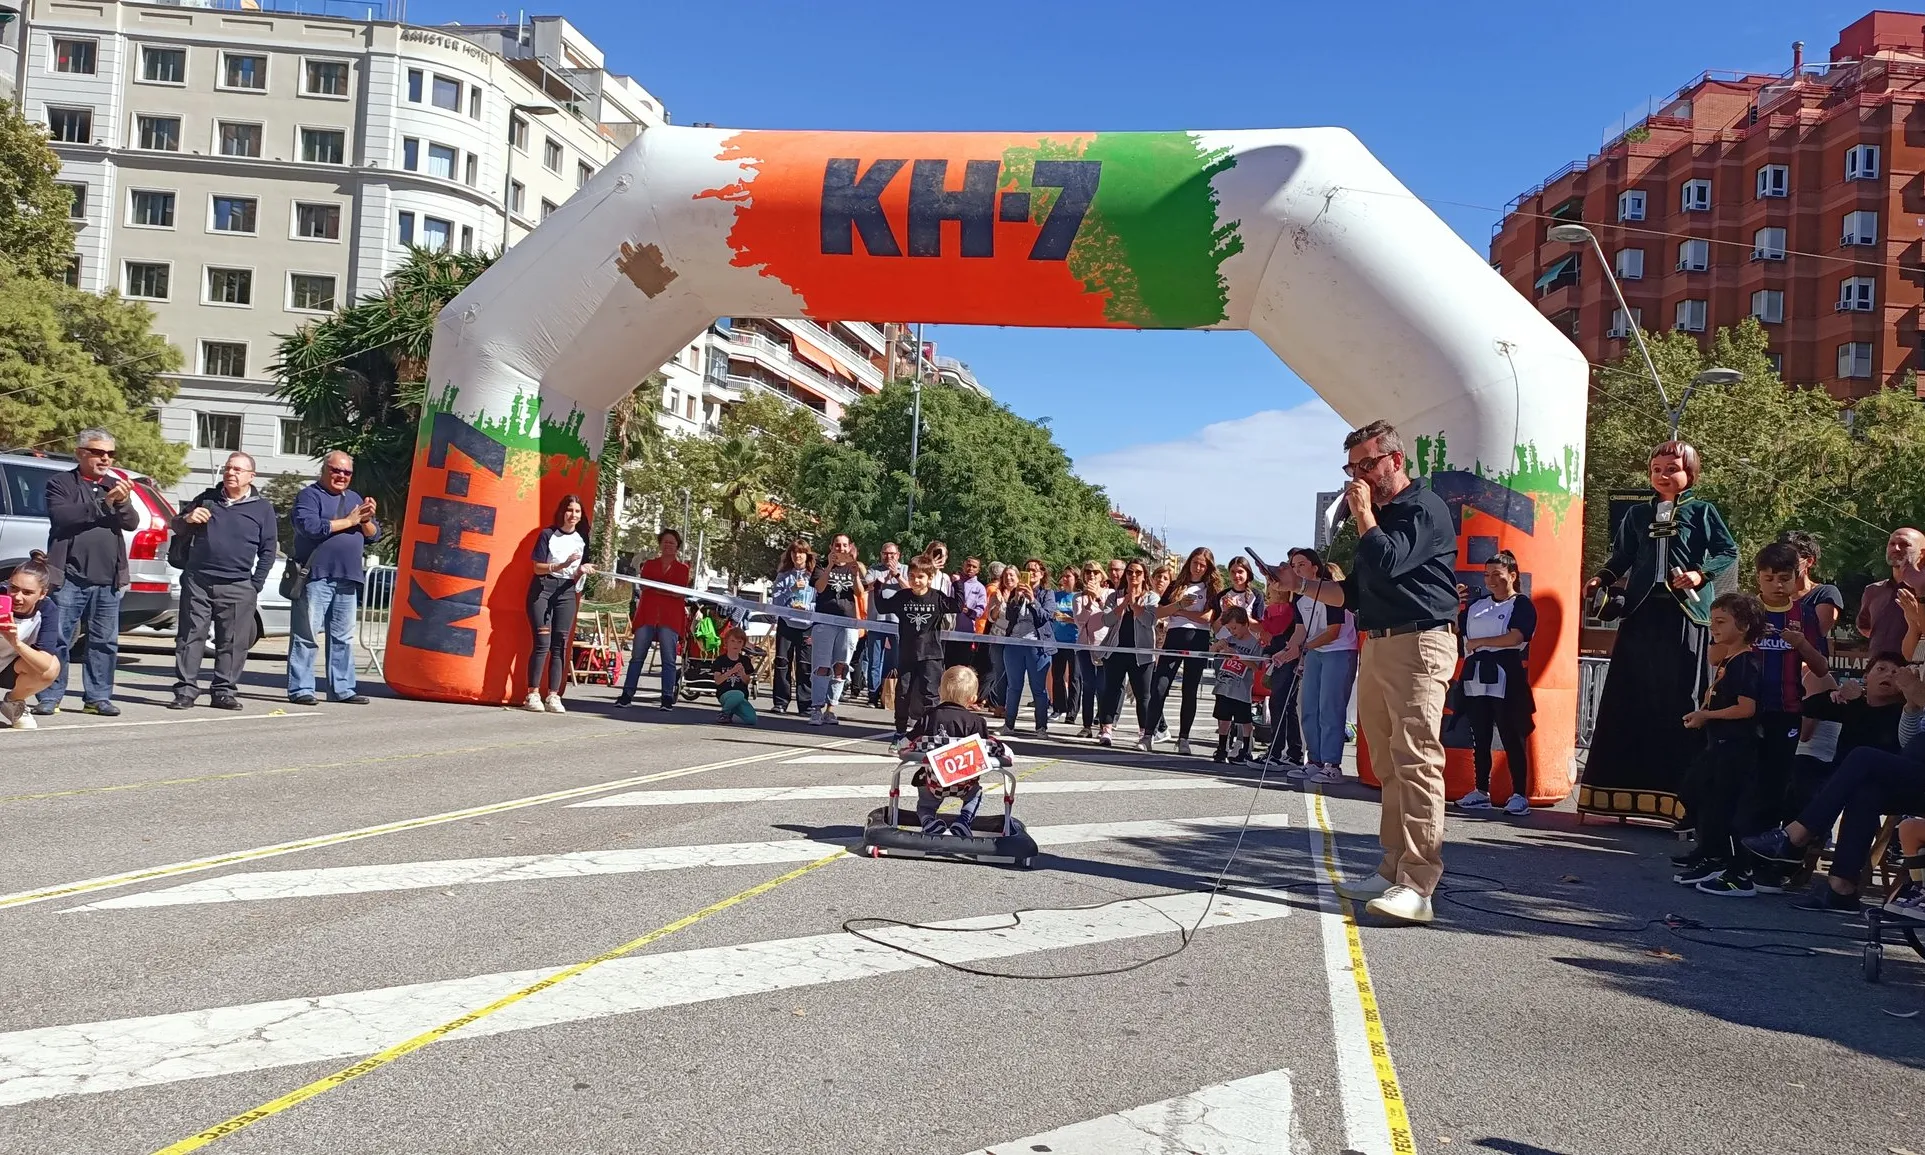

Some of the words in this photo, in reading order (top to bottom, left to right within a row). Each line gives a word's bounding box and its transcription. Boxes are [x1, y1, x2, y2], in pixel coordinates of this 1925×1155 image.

[820, 157, 1102, 261] KH-7
[400, 412, 507, 657] KH-7
[1752, 638, 1794, 650] akute
[1226, 660, 1243, 671] 025
[944, 750, 975, 774] 027
[432, 1015, 480, 1034] FECPC
[1370, 1040, 1387, 1057] FECPC
[328, 1059, 385, 1082] FECPC
[1381, 1079, 1401, 1101] FECPC
[198, 1111, 269, 1139] FECPC
[1392, 1127, 1413, 1154] FECPC
